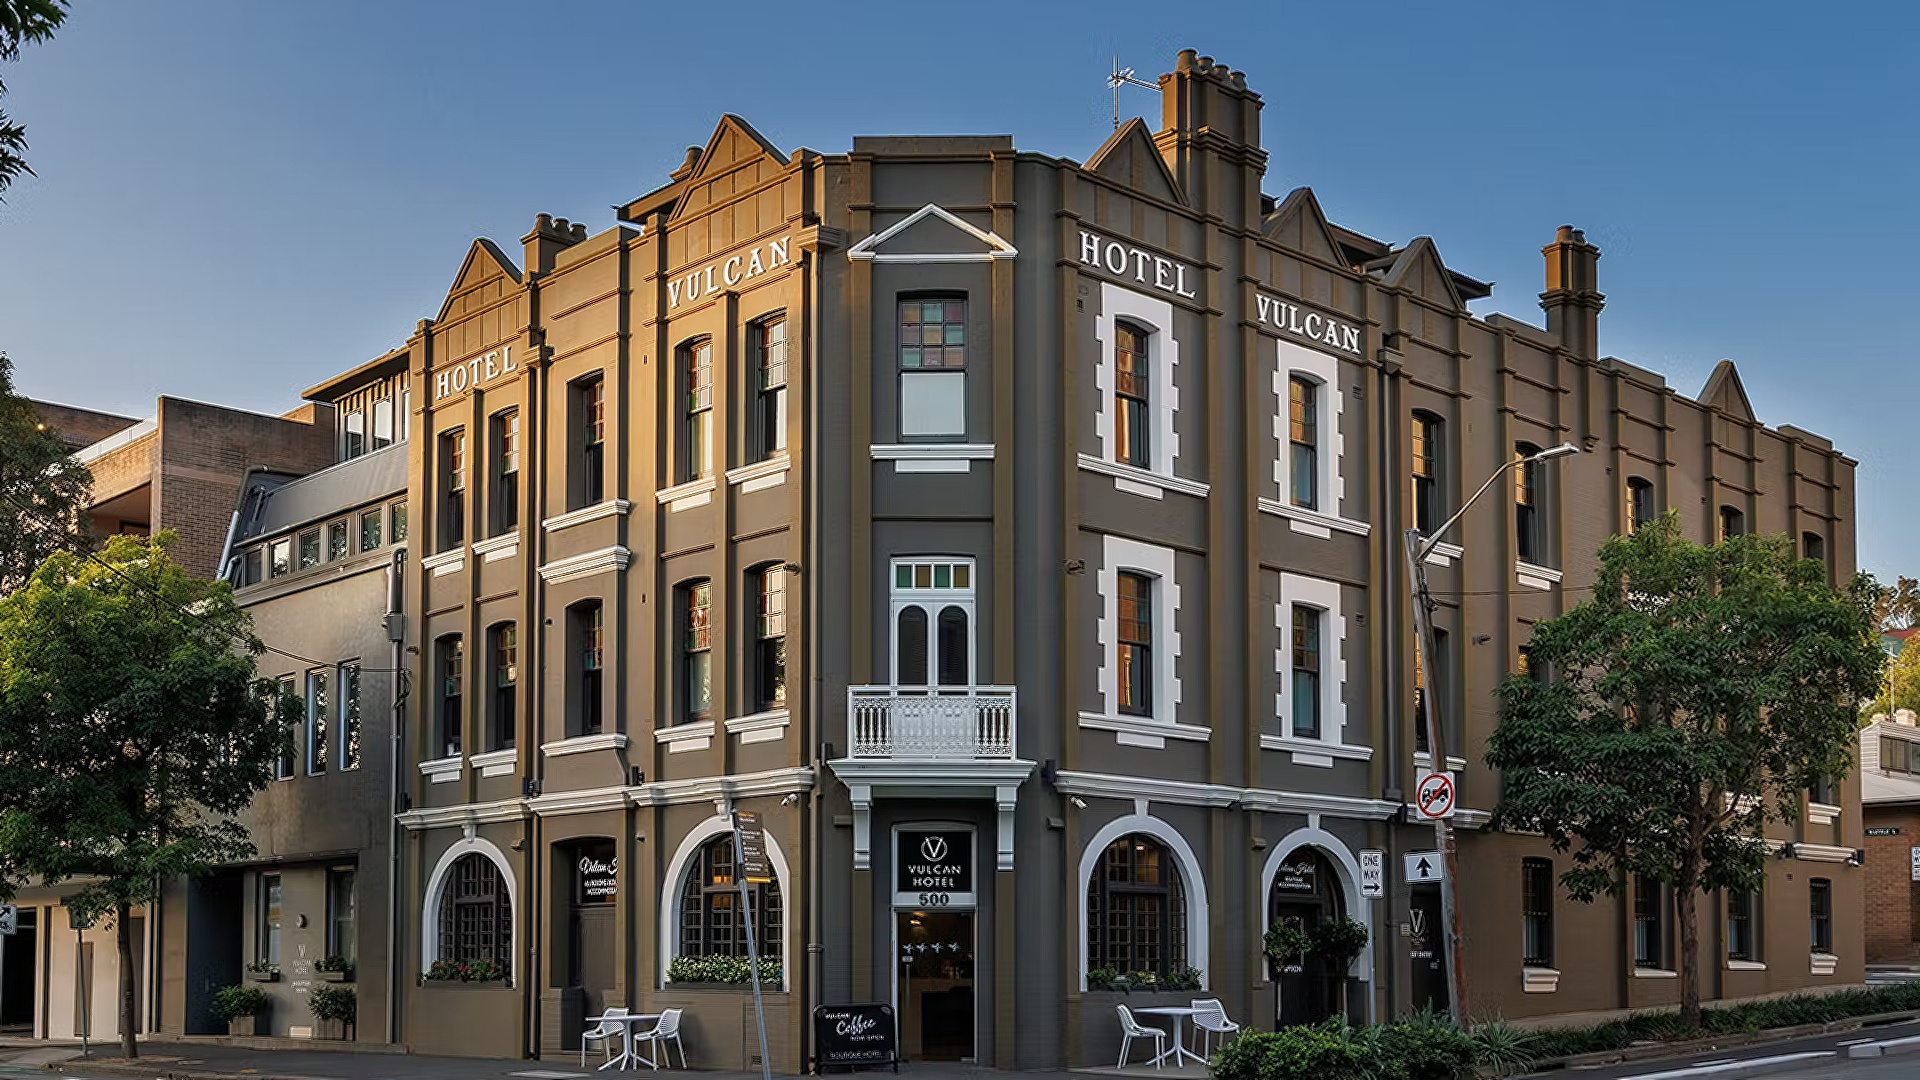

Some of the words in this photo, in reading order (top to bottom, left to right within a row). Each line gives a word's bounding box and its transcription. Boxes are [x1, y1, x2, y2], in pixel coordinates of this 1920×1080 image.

[666, 235, 791, 308] VULCAN
[1079, 230, 1196, 299] HOTEL
[1255, 293, 1361, 354] VULCAN
[436, 345, 518, 400] HOTEL
[1363, 855, 1380, 866] ONE
[908, 865, 961, 874] VULCAN
[1363, 870, 1380, 880] WAY
[913, 877, 954, 887] HOTEL
[919, 892, 949, 906] 500
[836, 1014, 876, 1035] Coffee
